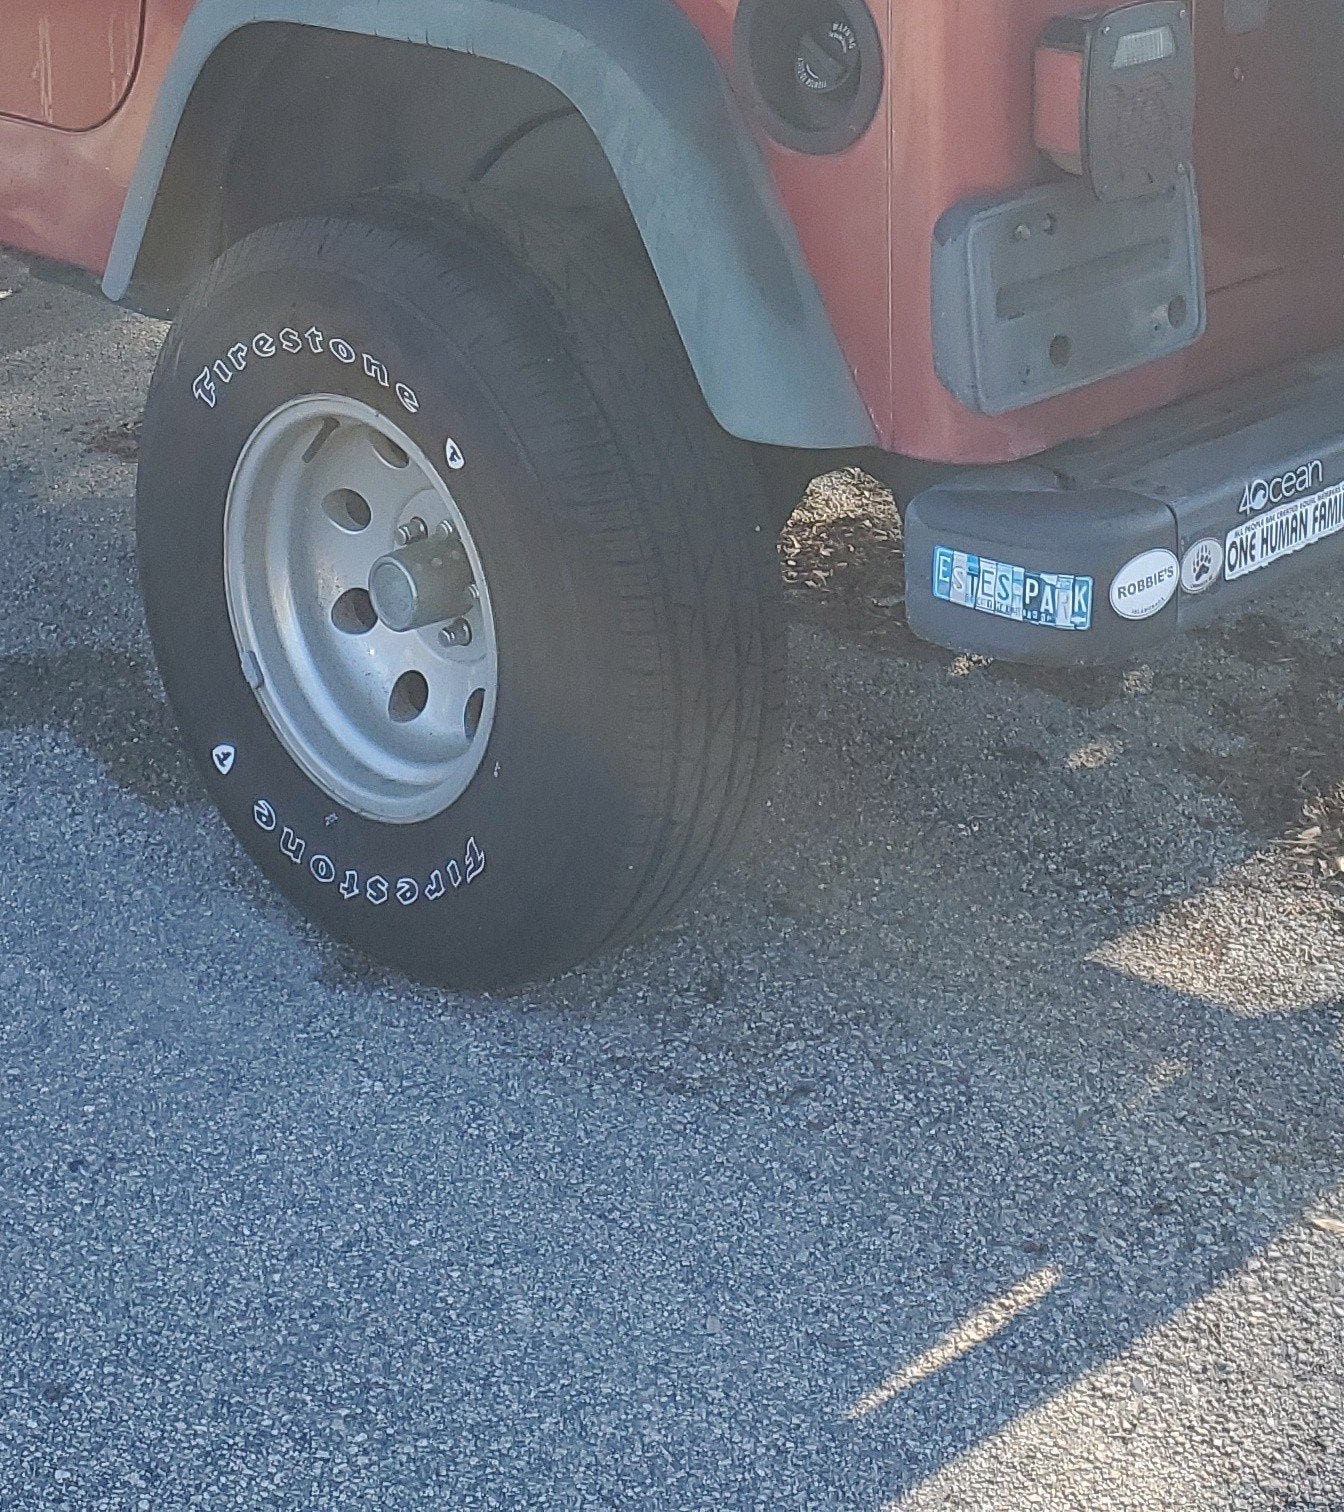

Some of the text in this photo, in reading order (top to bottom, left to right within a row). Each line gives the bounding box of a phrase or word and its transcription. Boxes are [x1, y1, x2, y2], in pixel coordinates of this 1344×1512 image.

[192, 327, 419, 414] Firestone
[1227, 530, 1256, 572] ONE
[1260, 507, 1308, 559] HUMAN
[939, 555, 1010, 601] ESTES
[1025, 577, 1087, 620] PARK
[1117, 565, 1174, 600] ROBBIE'S
[254, 799, 485, 905] Firestone
